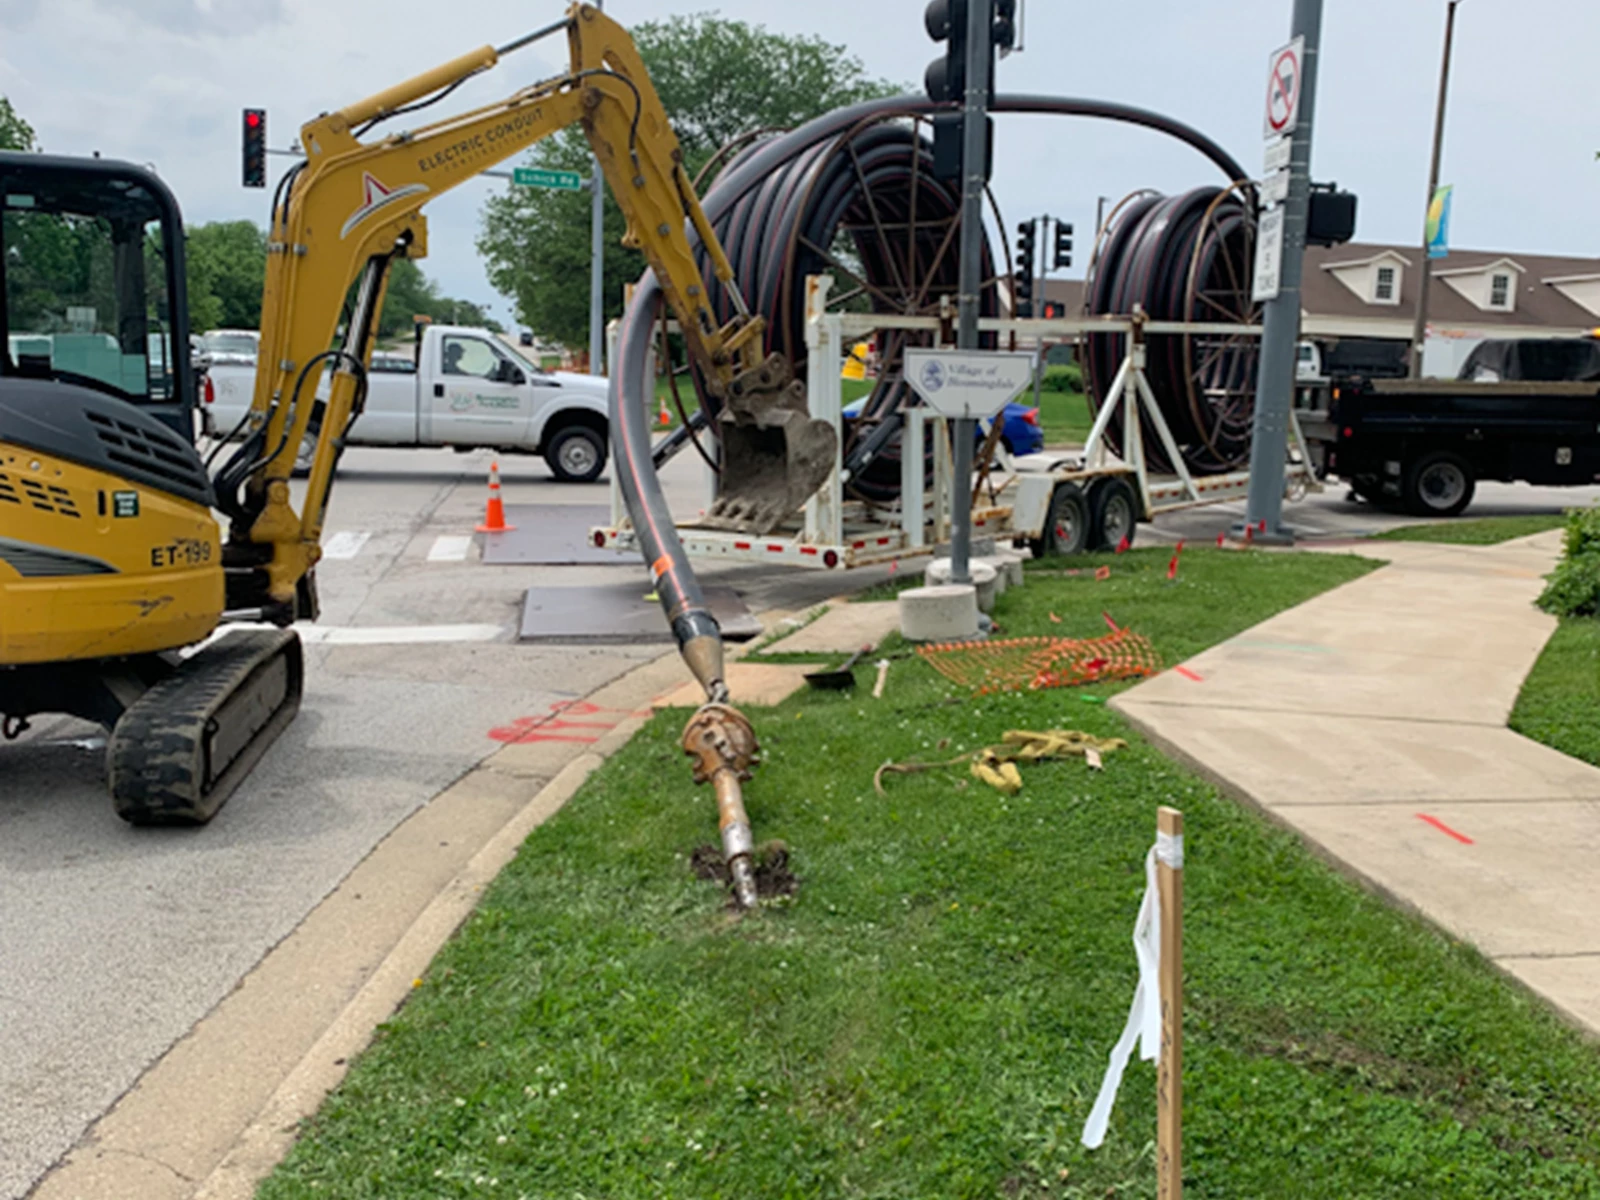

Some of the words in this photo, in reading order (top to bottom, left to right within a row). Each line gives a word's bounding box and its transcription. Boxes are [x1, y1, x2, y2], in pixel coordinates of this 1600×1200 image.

[418, 133, 484, 173] ELECTRIC
[484, 106, 545, 143] CONDUIT
[559, 174, 576, 186] Rd
[948, 363, 983, 377] Village
[985, 363, 1000, 375] of
[150, 539, 212, 568] ET-199
